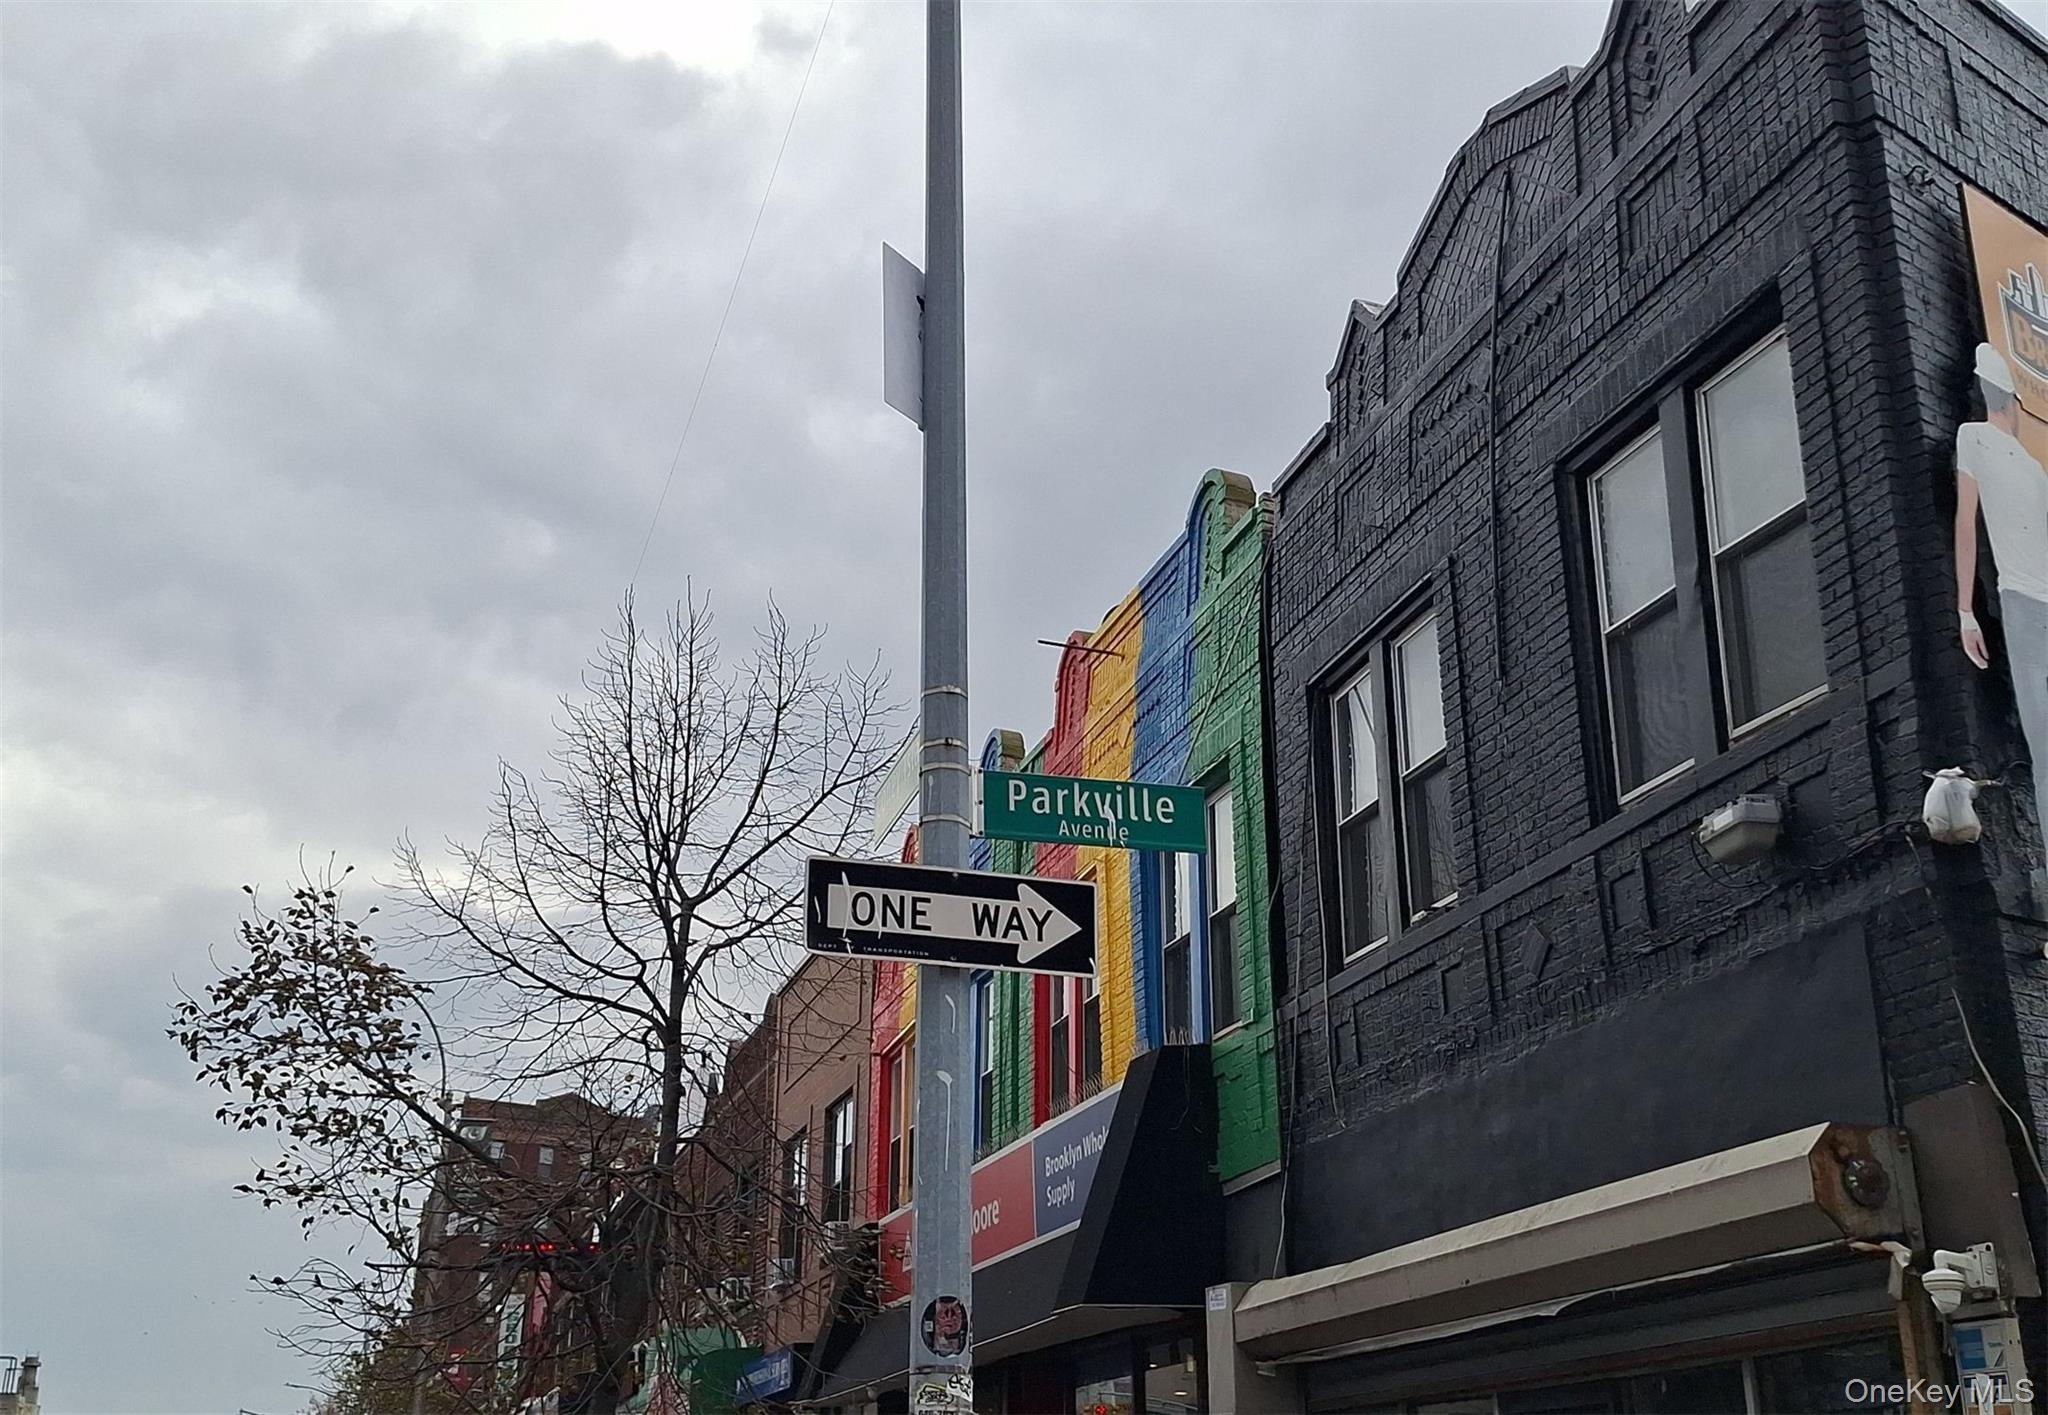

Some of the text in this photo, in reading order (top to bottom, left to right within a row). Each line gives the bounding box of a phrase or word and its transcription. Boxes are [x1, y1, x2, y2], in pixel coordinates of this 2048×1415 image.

[1008, 779, 1175, 824] Parkville
[1058, 819, 1129, 841] Avenue
[850, 891, 1054, 943] ONE WAY
[1045, 1143, 1082, 1177] Brooklyn
[1046, 1176, 1076, 1208] Supply
[971, 1199, 1000, 1236] oore
